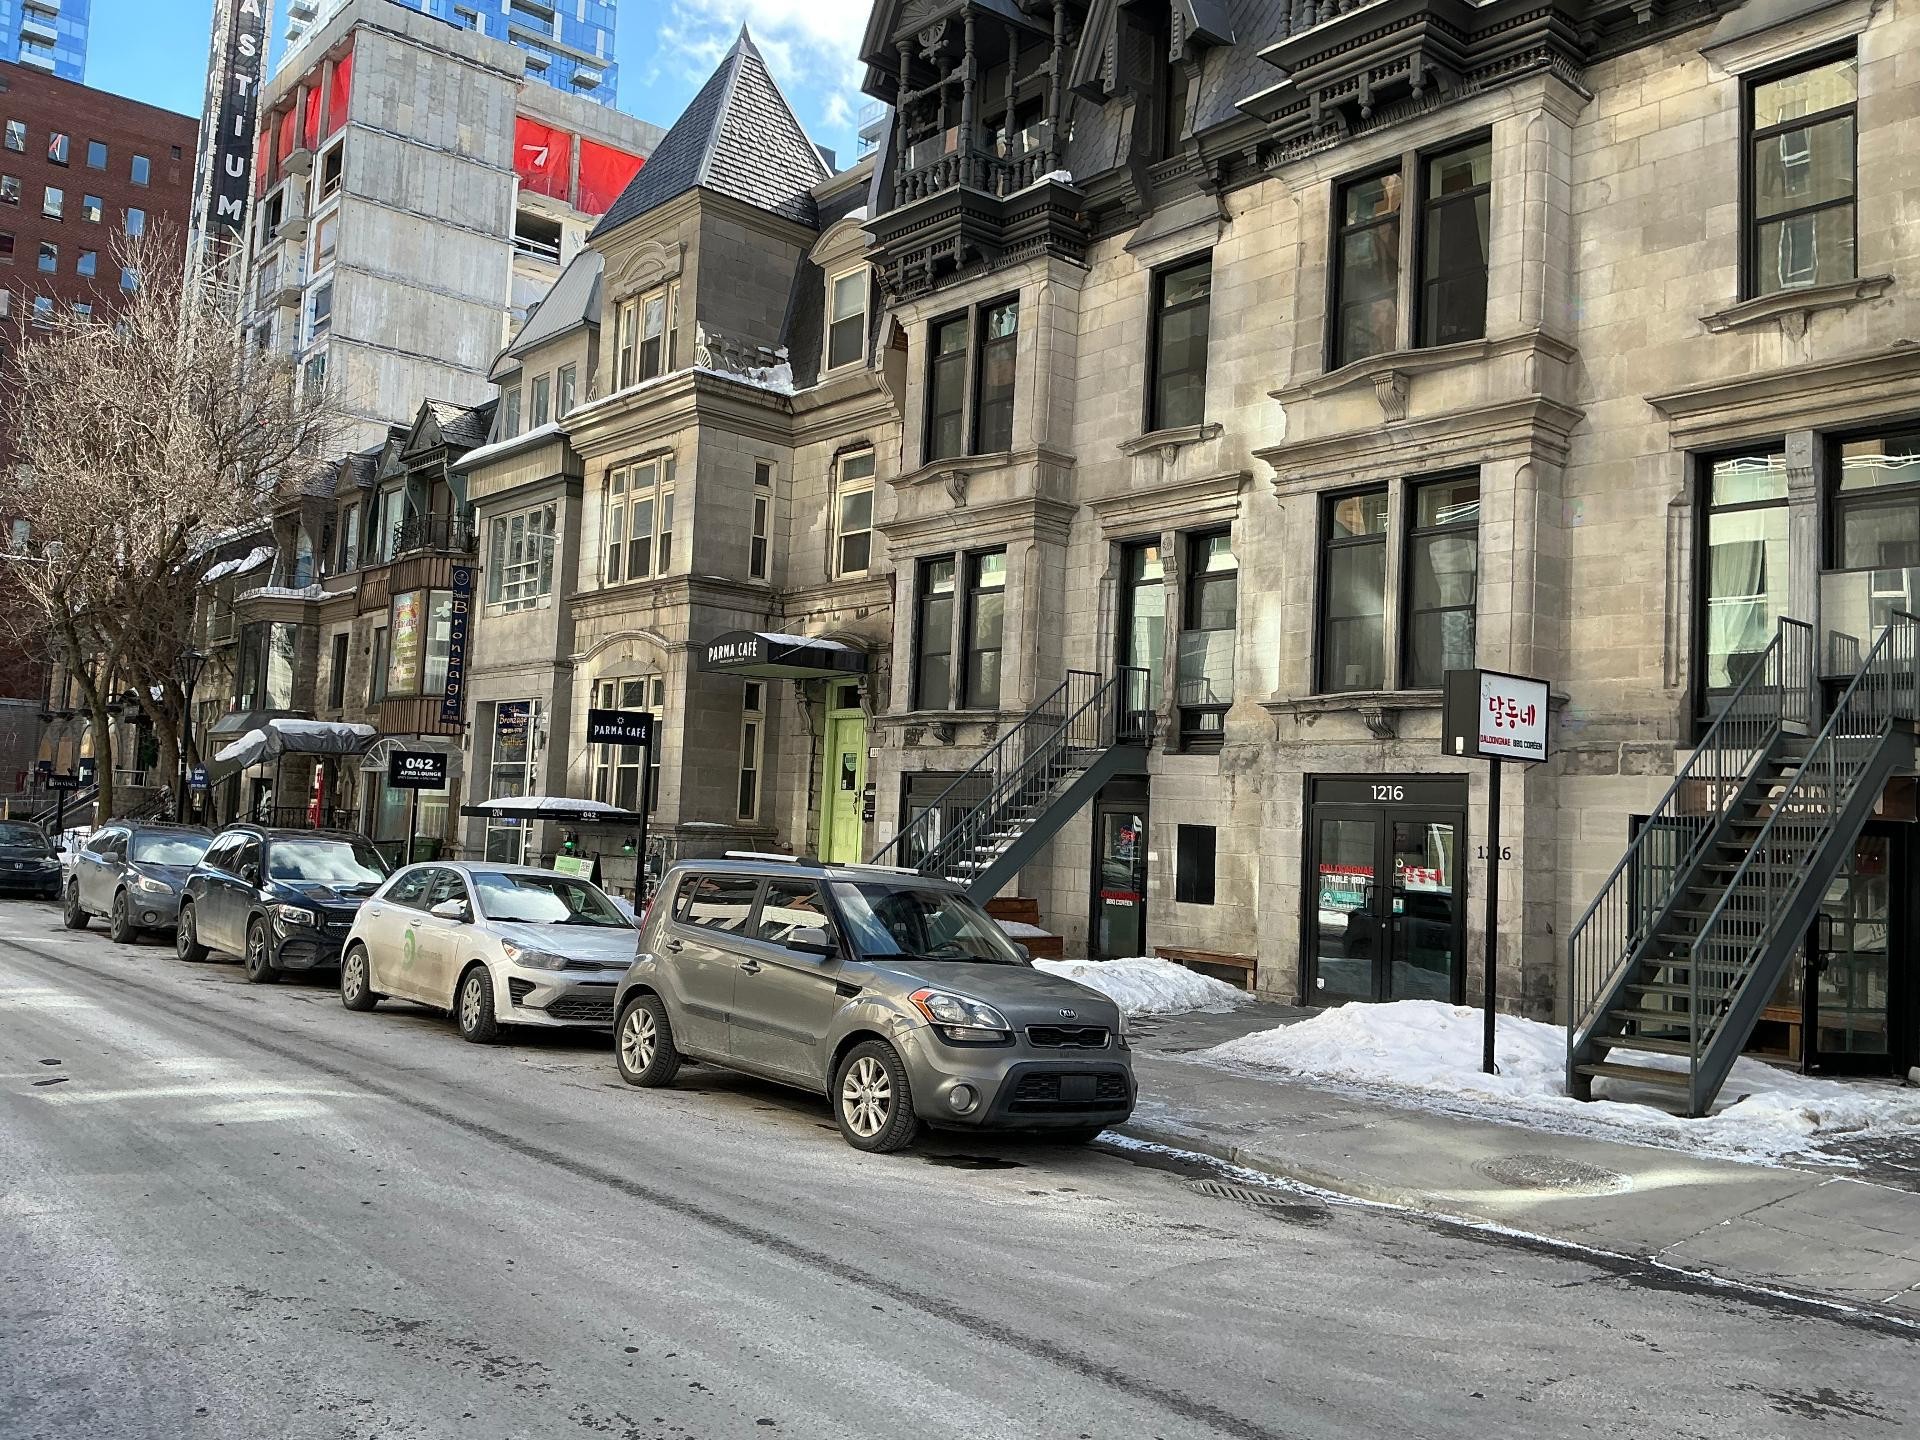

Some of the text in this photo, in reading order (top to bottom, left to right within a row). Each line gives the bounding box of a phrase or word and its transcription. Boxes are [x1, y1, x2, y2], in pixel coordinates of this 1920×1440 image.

[446, 600, 468, 707] Bronzage
[708, 637, 758, 663] PARMA CAFÉ
[1489, 695, 1536, 729] 달동네
[499, 713, 528, 727] Bronzage
[594, 725, 646, 739] PARMA CAFÉ
[1513, 739, 1523, 748] BBQ
[405, 757, 434, 770] 042
[1371, 785, 1404, 801] 1216
[492, 809, 503, 817] 1204
[1477, 845, 1512, 860] 16
[1327, 875, 1366, 885] TABLE BBQ
